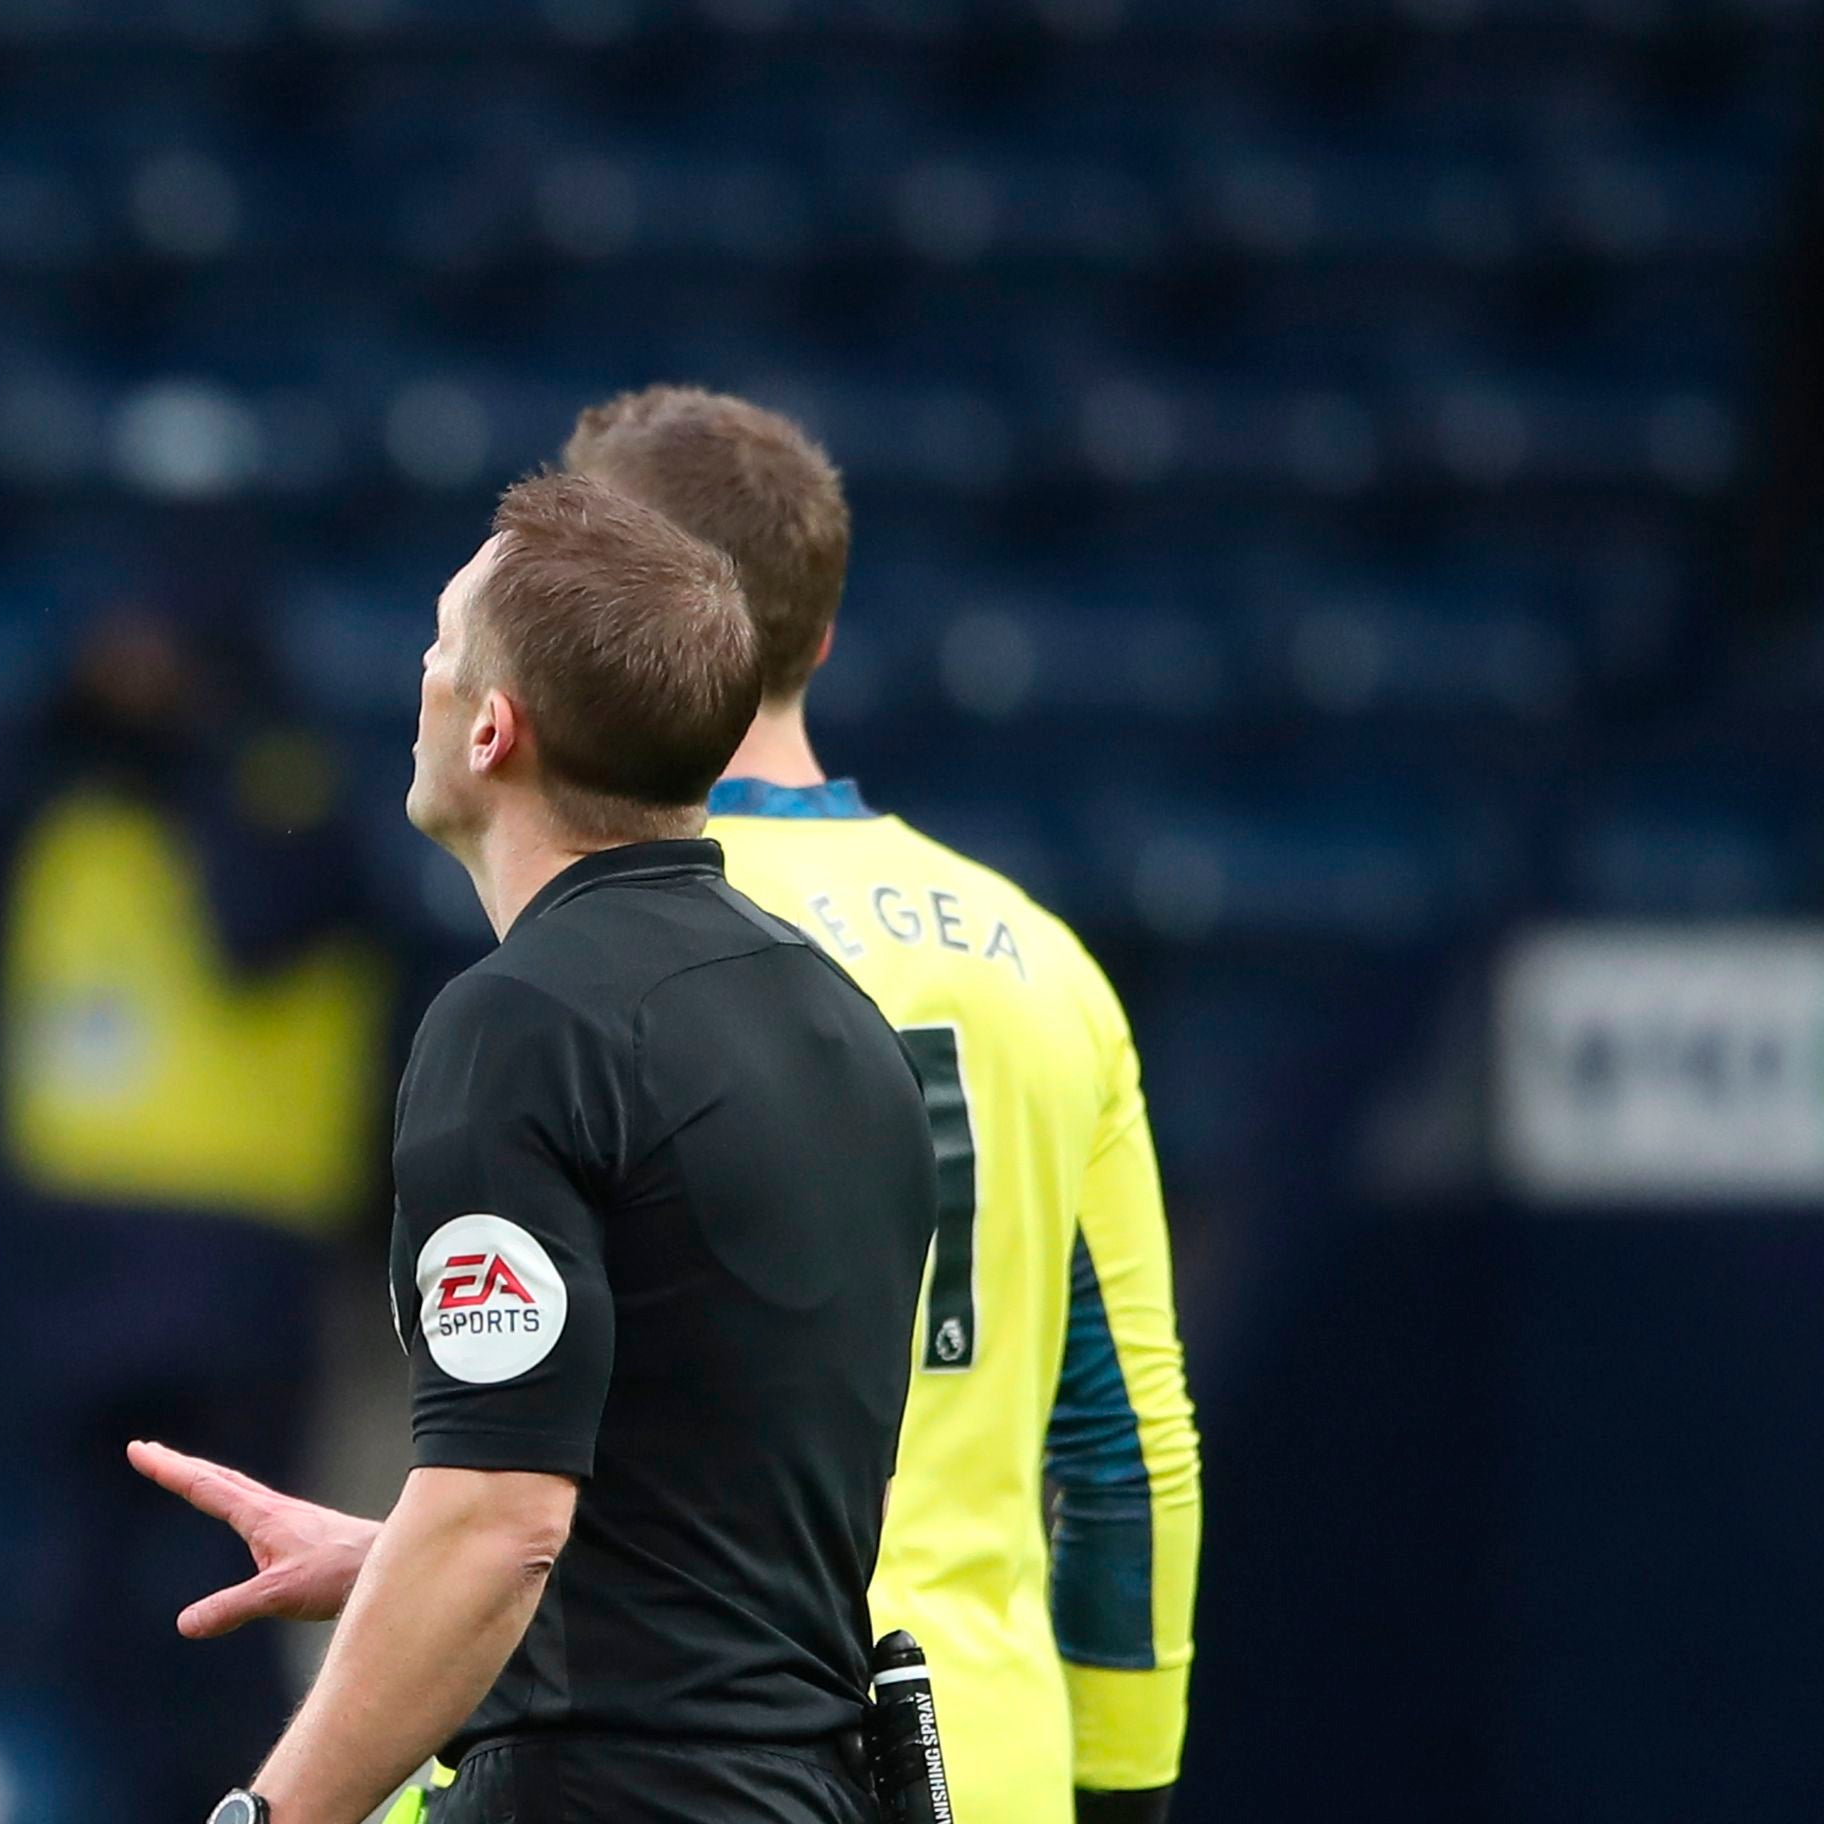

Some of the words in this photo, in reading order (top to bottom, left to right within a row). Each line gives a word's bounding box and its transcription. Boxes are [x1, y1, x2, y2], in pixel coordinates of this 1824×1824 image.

[872, 886, 1027, 983] GEA
[437, 1253, 537, 1310] EA
[438, 1308, 541, 1337] SPORTS
[915, 1691, 939, 1747] SPRAY
